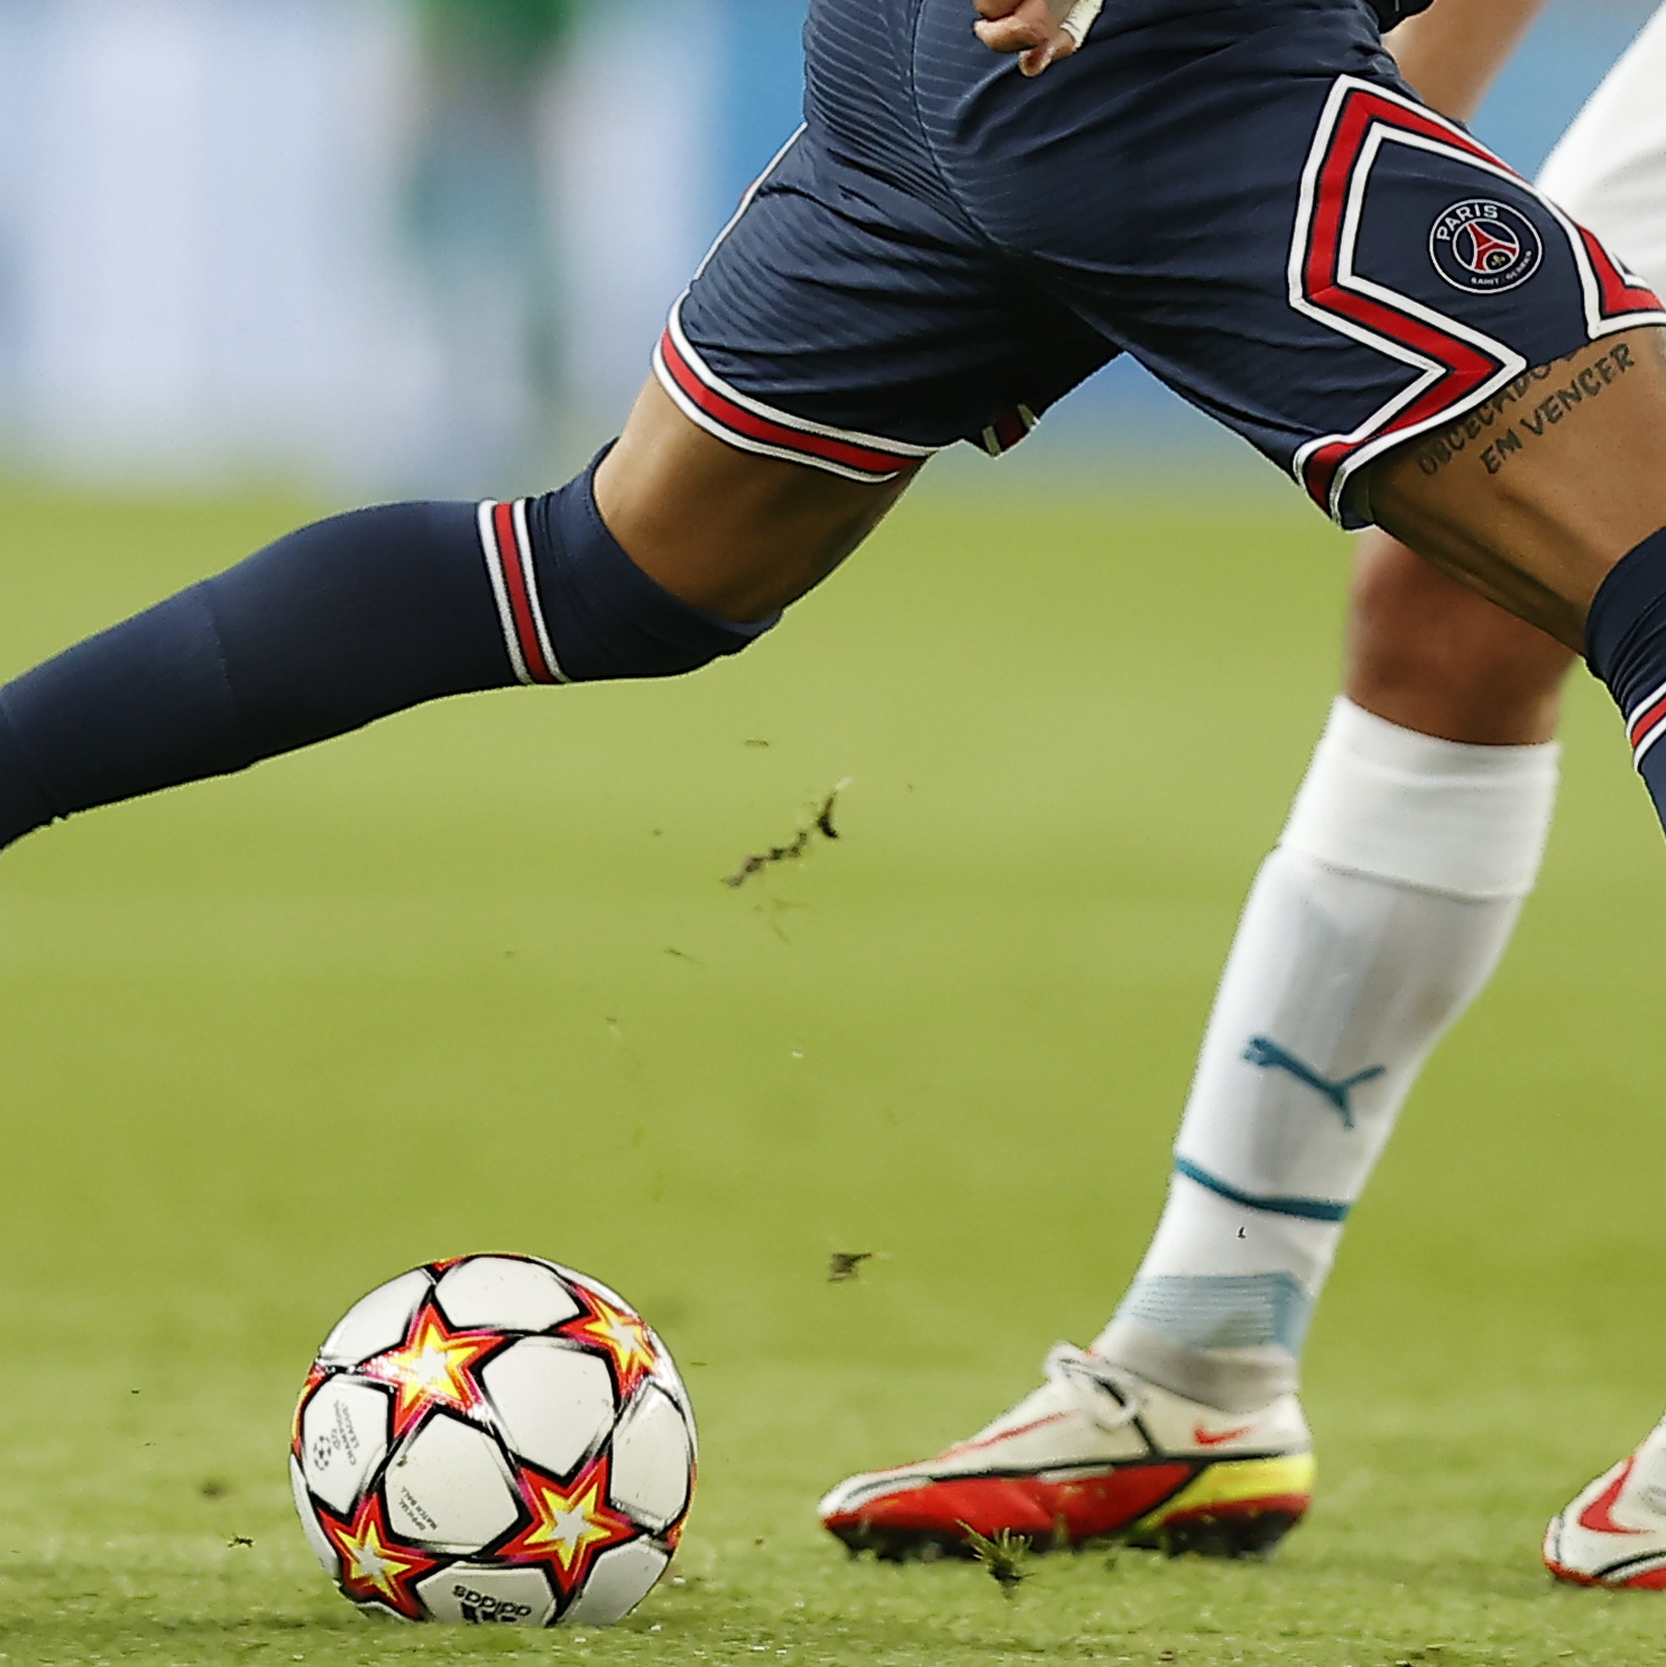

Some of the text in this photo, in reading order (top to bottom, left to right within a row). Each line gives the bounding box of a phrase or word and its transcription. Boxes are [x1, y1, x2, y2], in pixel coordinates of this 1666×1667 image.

[1436, 203, 1498, 241] PARIS
[1480, 343, 1635, 475] EM VENCER
[452, 1585, 532, 1617] adidas
